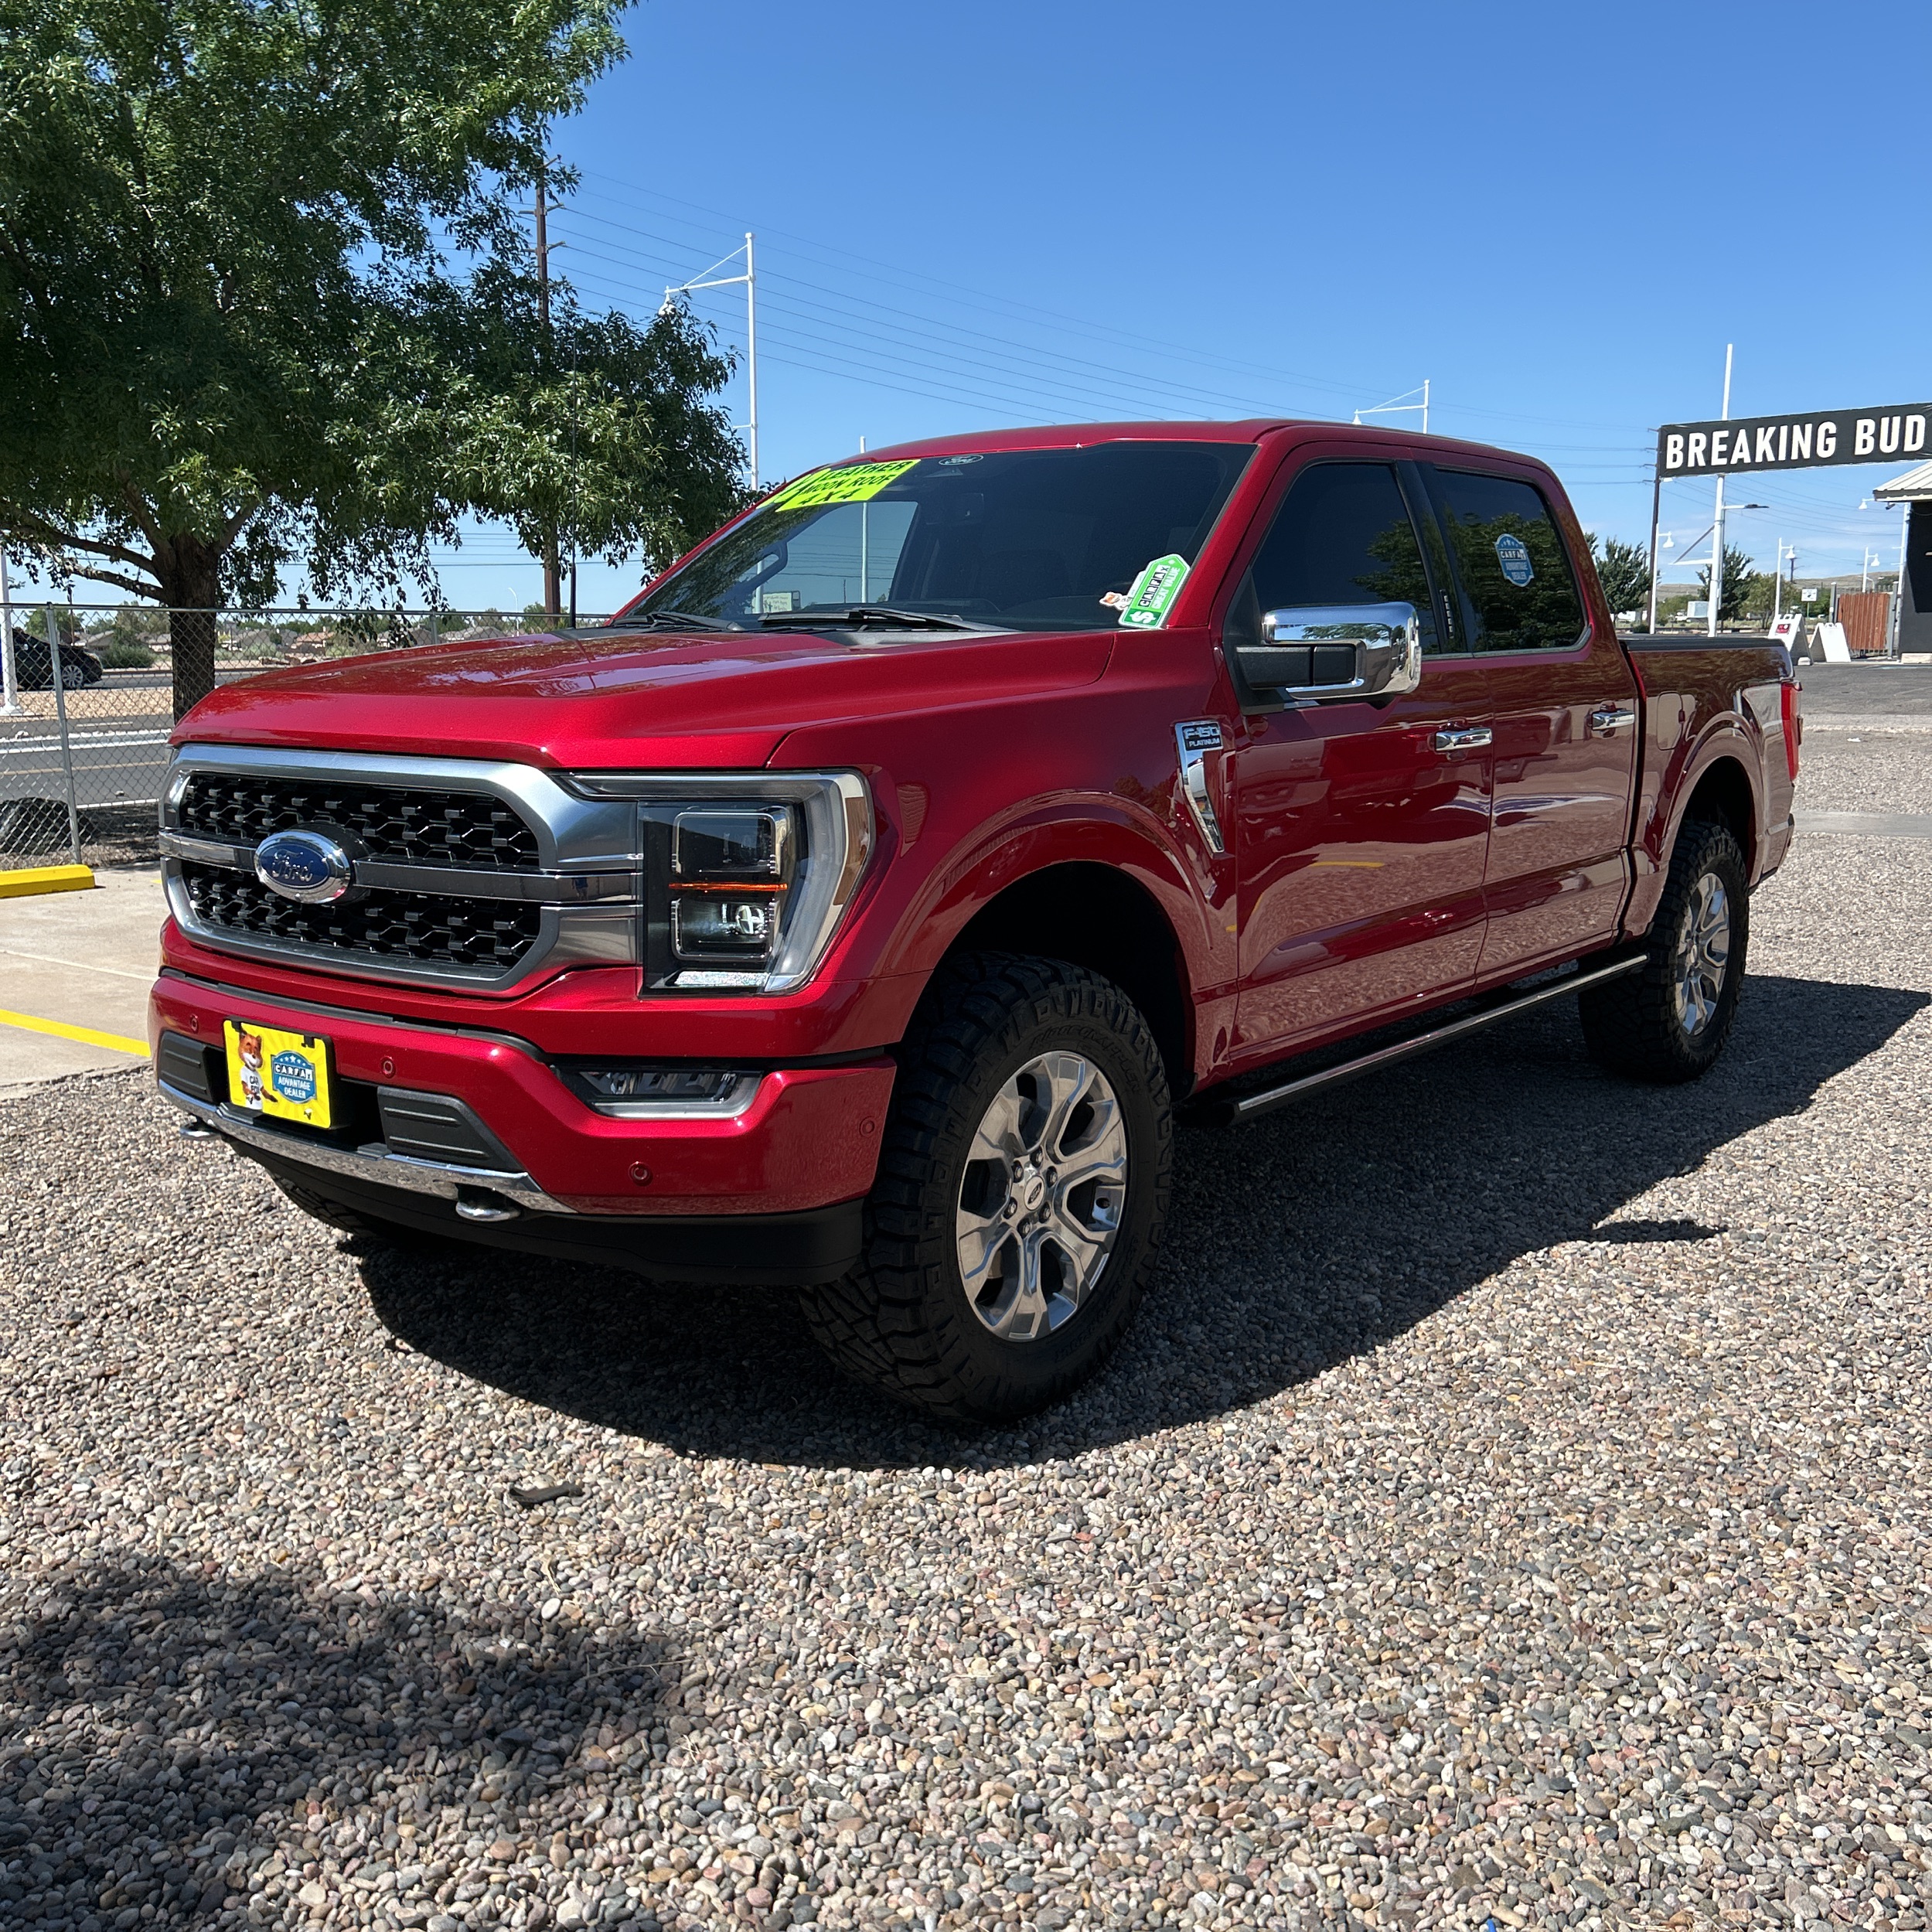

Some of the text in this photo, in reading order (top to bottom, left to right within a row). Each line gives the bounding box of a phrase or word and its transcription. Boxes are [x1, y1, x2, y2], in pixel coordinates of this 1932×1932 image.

[1665, 414, 1926, 469] BREAKING BUD
[819, 461, 913, 482] LEATHER
[799, 474, 897, 496] MOON ROOF
[1138, 565, 1170, 608] CARFAX
[1151, 567, 1181, 609] GREAT VALUE
[1184, 726, 1220, 740] F-150
[1188, 738, 1220, 748] PLATINUM
[274, 1064, 312, 1081] CARFAX
[278, 1076, 311, 1091] ADVANTAGE
[284, 1087, 306, 1099] DEALER
